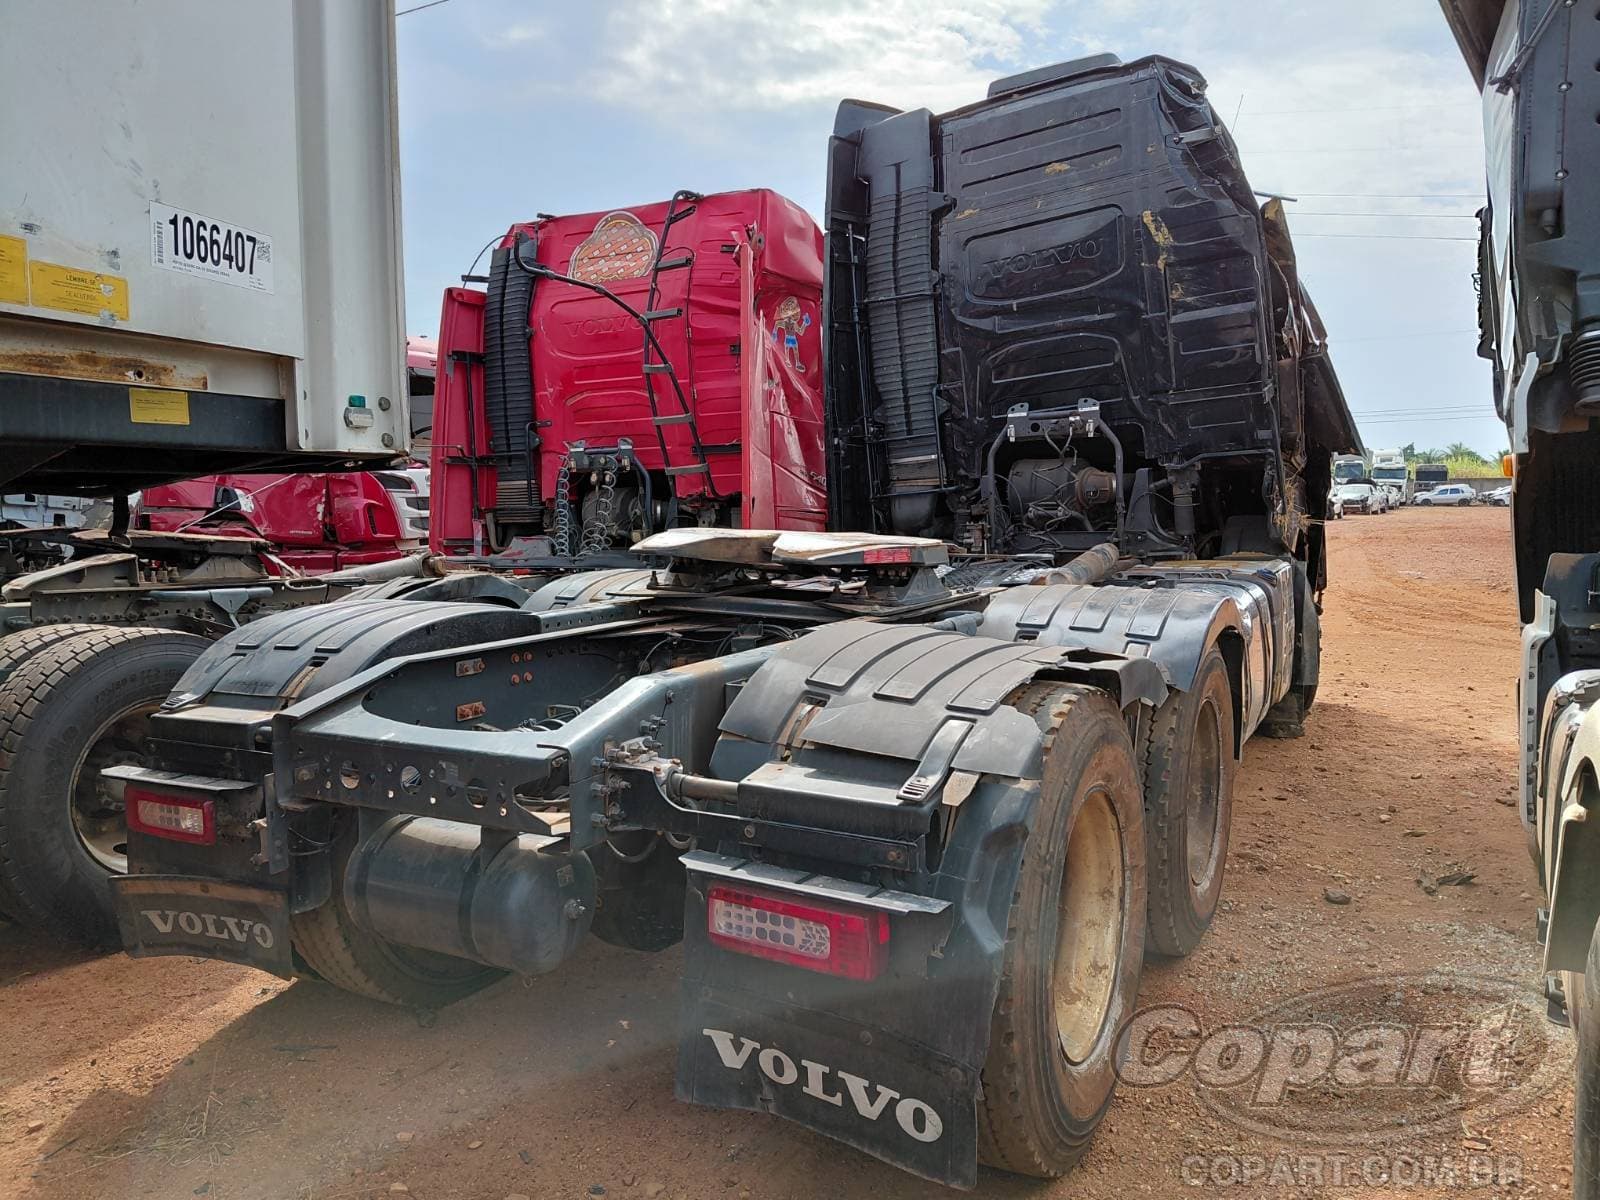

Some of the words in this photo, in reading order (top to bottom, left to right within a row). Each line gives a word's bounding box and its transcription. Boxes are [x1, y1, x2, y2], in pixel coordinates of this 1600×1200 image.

[168, 213, 257, 275] 1066407
[983, 239, 1104, 278] VOLVO
[140, 910, 274, 949] VOLVO
[702, 1028, 944, 1143] VOLVO
